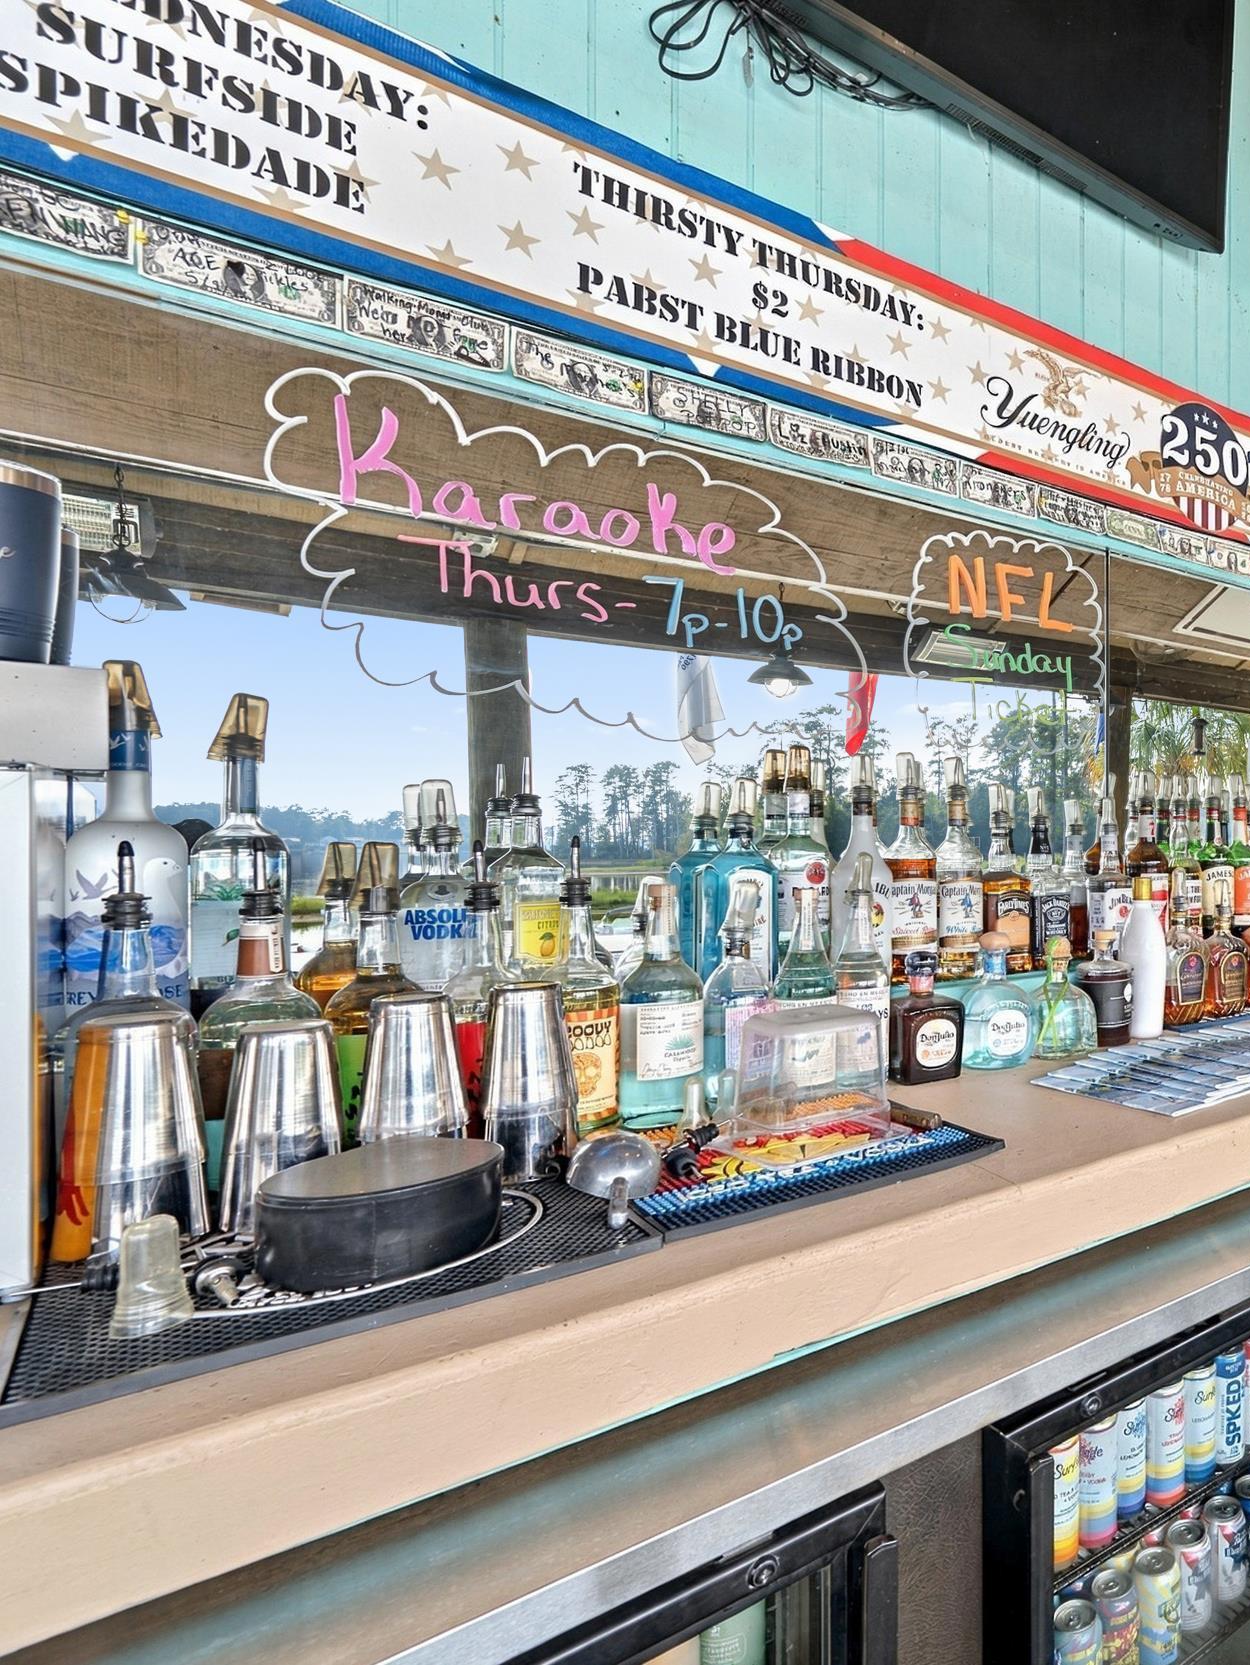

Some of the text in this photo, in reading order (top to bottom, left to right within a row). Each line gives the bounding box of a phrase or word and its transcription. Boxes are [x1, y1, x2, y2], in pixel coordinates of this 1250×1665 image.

[36, 3, 358, 157] SURFSIDE
[130, 0, 430, 130] DNESDAY:
[0, 50, 366, 214] SPIKEDADE
[572, 161, 926, 333] THIRSTY THURSDAY:
[576, 261, 924, 409] PABST BLUE RIBBON
[752, 281, 789, 320] $2
[980, 375, 1131, 470] Yuengling
[1161, 413, 1250, 488] 250
[334, 393, 736, 576] Karaoke
[1176, 481, 1236, 511] AMERICA
[397, 534, 637, 624] Thurs-
[948, 554, 1073, 632] NFL
[943, 623, 1073, 692] Sunday
[892, 883, 915, 897] aptain
[1206, 870, 1233, 881] JAMES
[568, 1020, 612, 1039] OOVY
